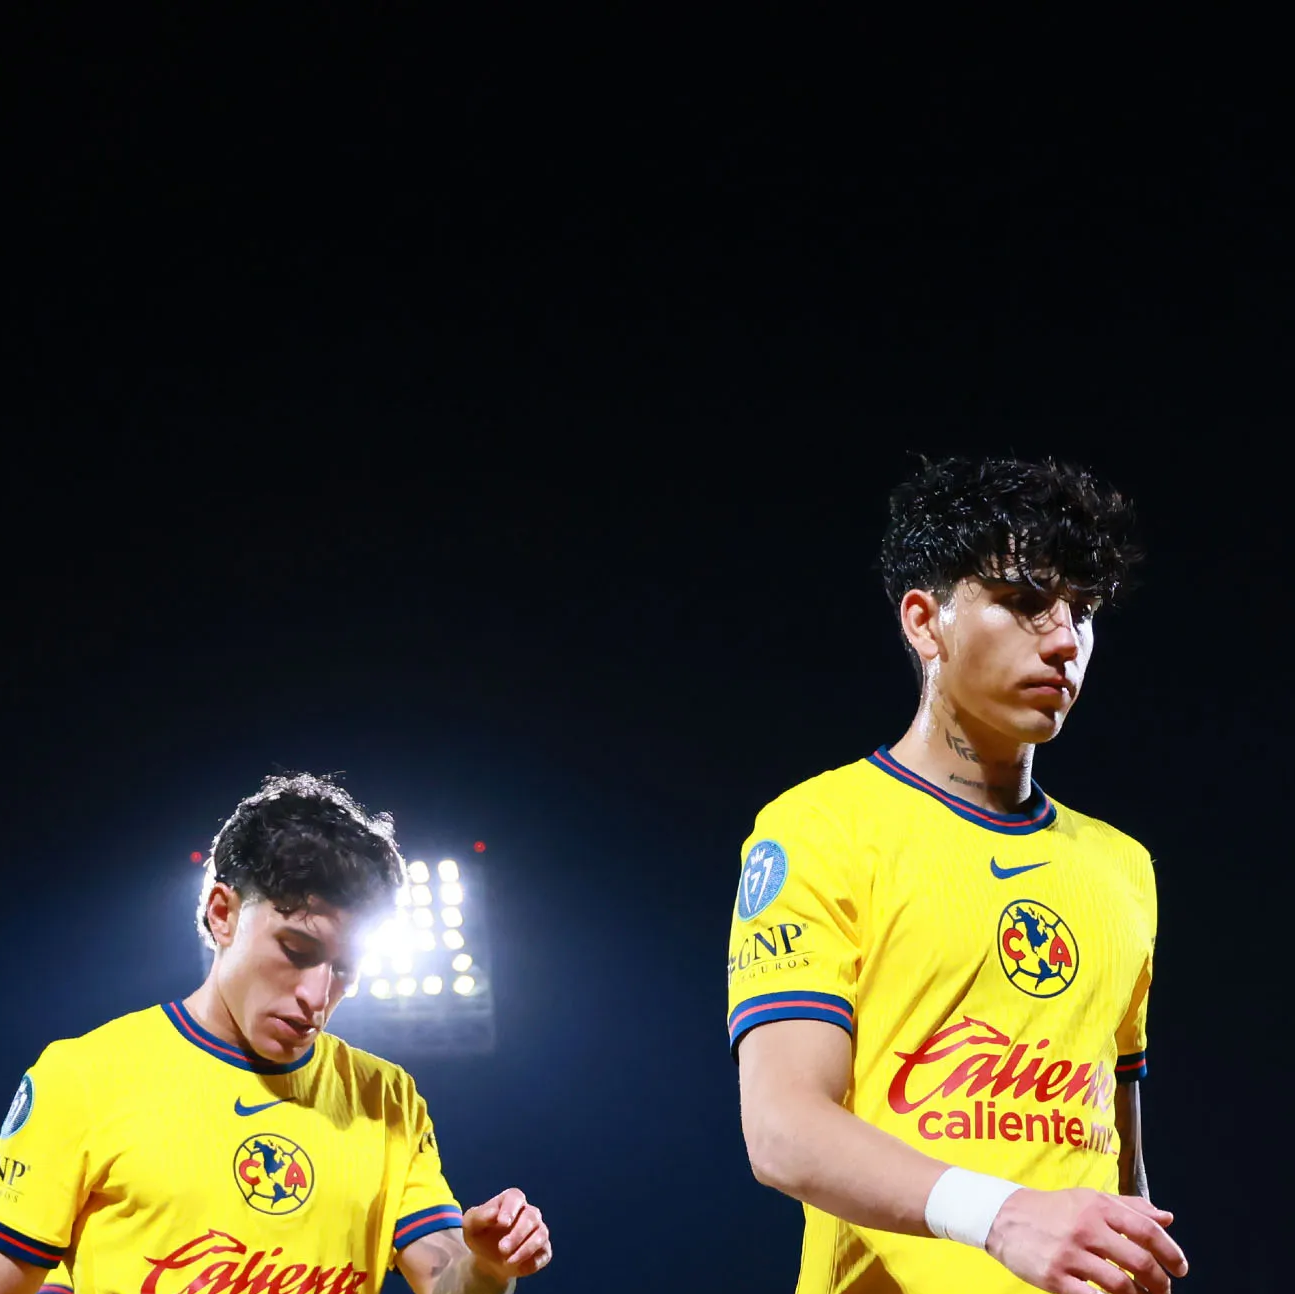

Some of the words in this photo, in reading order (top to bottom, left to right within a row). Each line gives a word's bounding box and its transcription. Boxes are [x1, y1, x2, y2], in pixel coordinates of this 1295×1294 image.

[738, 923, 803, 970] GNP
[887, 1015, 1115, 1115] Caliente
[918, 1101, 1118, 1155] caliente.mx
